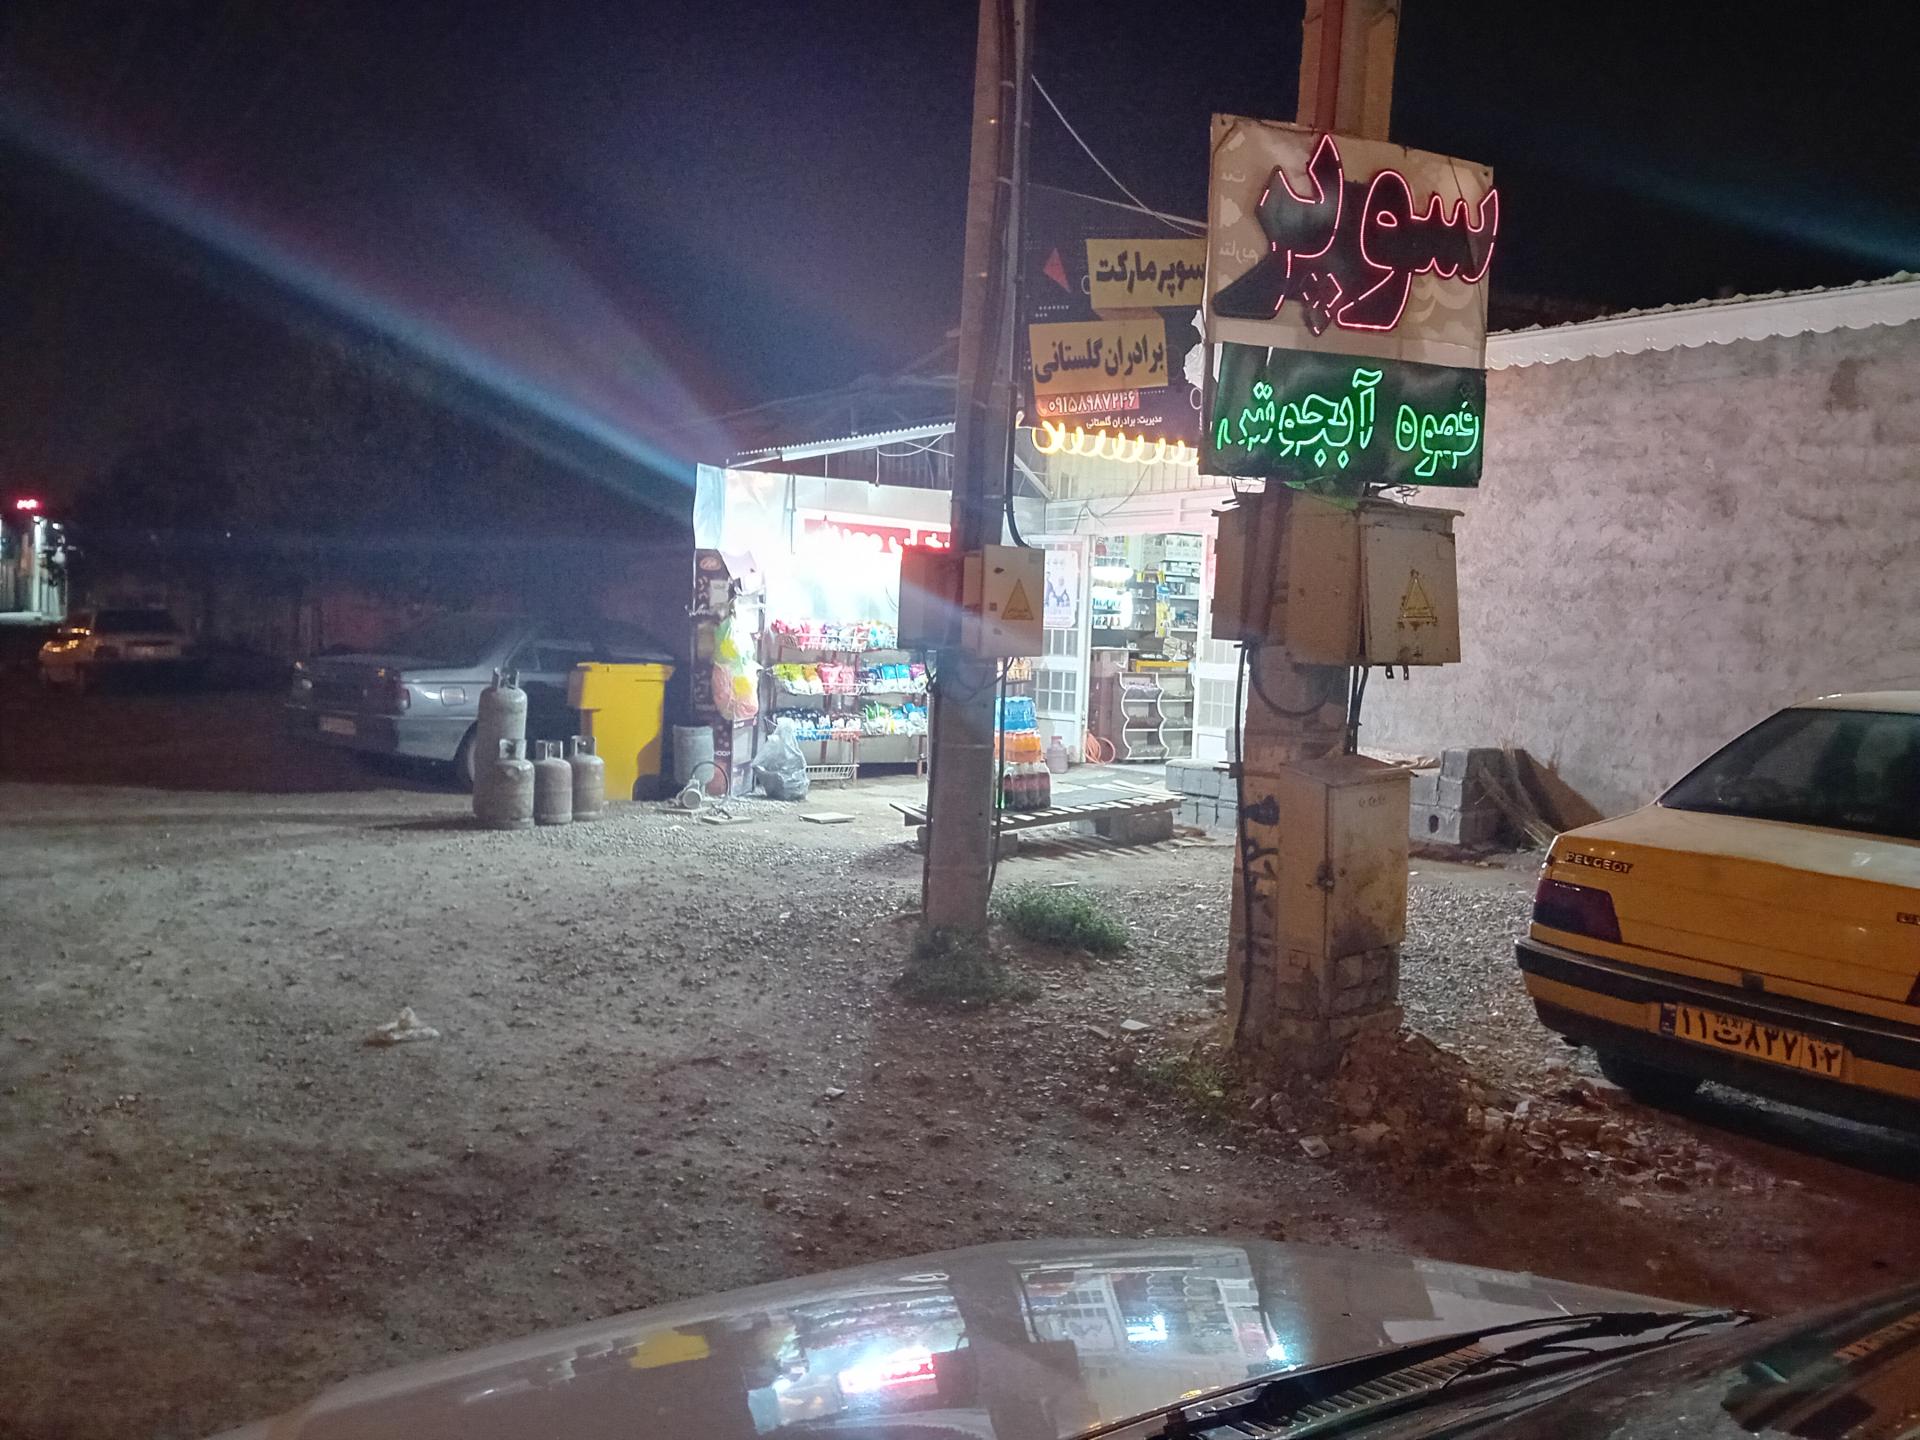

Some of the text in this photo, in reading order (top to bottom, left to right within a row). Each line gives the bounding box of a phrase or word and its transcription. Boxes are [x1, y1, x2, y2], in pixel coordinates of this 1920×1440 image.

[1034, 333, 1164, 383] برادران گلستانی
[1565, 851, 1633, 874] PEUGEOT
[1714, 1013, 1744, 1030] TAXI
